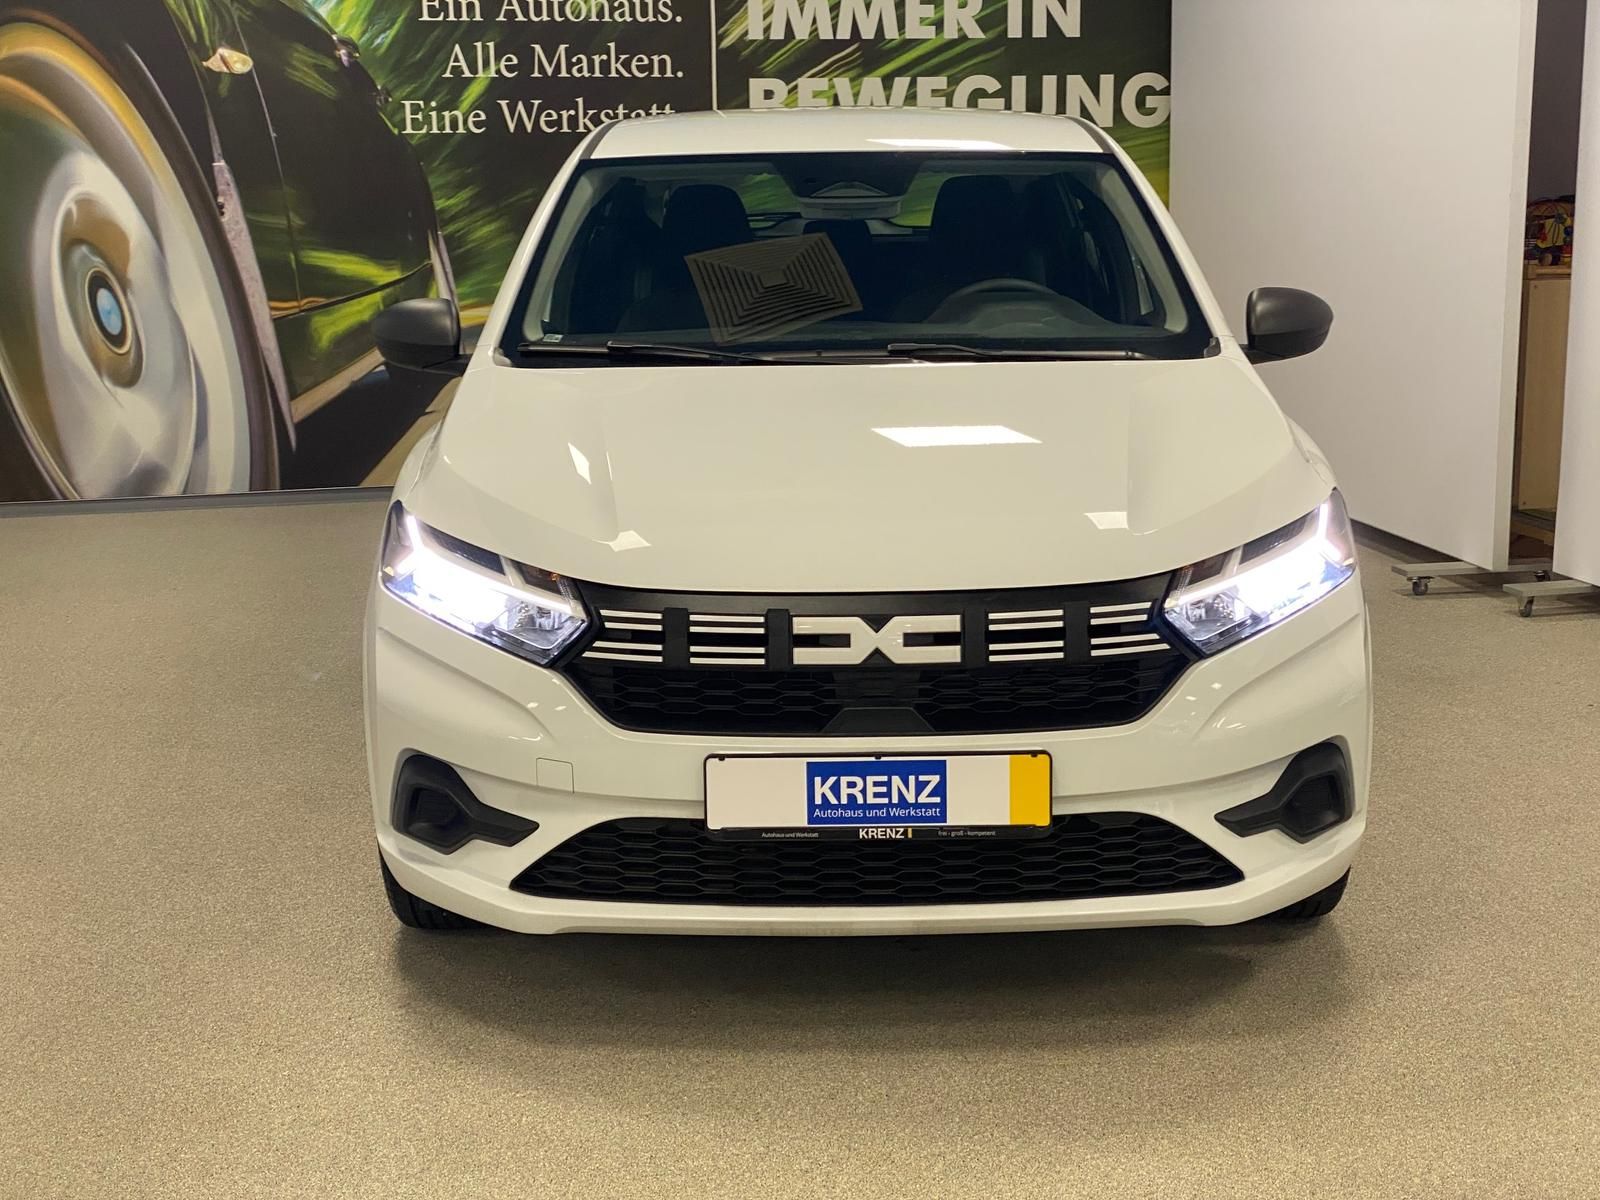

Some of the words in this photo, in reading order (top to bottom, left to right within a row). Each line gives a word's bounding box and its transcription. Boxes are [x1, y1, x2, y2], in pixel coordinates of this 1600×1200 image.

[418, 0, 484, 21] Ein
[496, 0, 683, 22] Autohaus.
[747, 0, 986, 40] IMMER
[1006, 0, 1081, 38] IN
[441, 41, 519, 78] Alle
[530, 42, 684, 78] Marken.
[400, 100, 487, 134] Eine
[814, 775, 941, 805] KRENZ
[813, 808, 863, 818] Autohaus
[866, 808, 886, 817] und
[888, 807, 941, 817] Werkstatt
[859, 828, 905, 839] KRENZ
